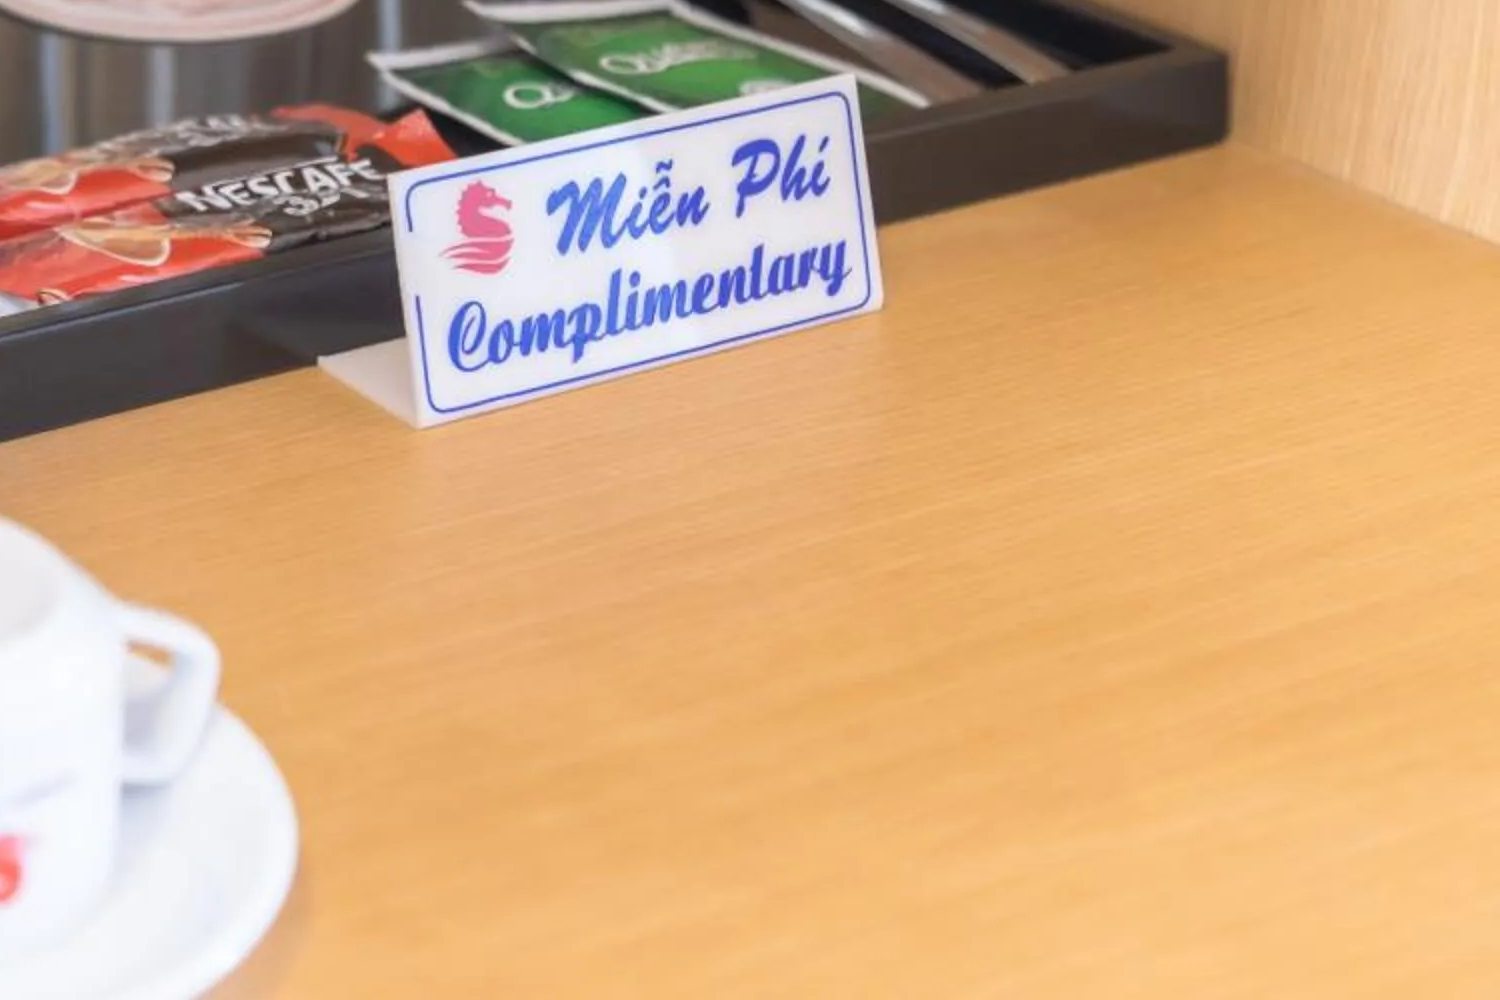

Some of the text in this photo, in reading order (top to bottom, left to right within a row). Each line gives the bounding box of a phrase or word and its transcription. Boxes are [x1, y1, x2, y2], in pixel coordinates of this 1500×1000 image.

[546, 134, 831, 256] Miễn Phí
[447, 239, 853, 372] Complimentary
